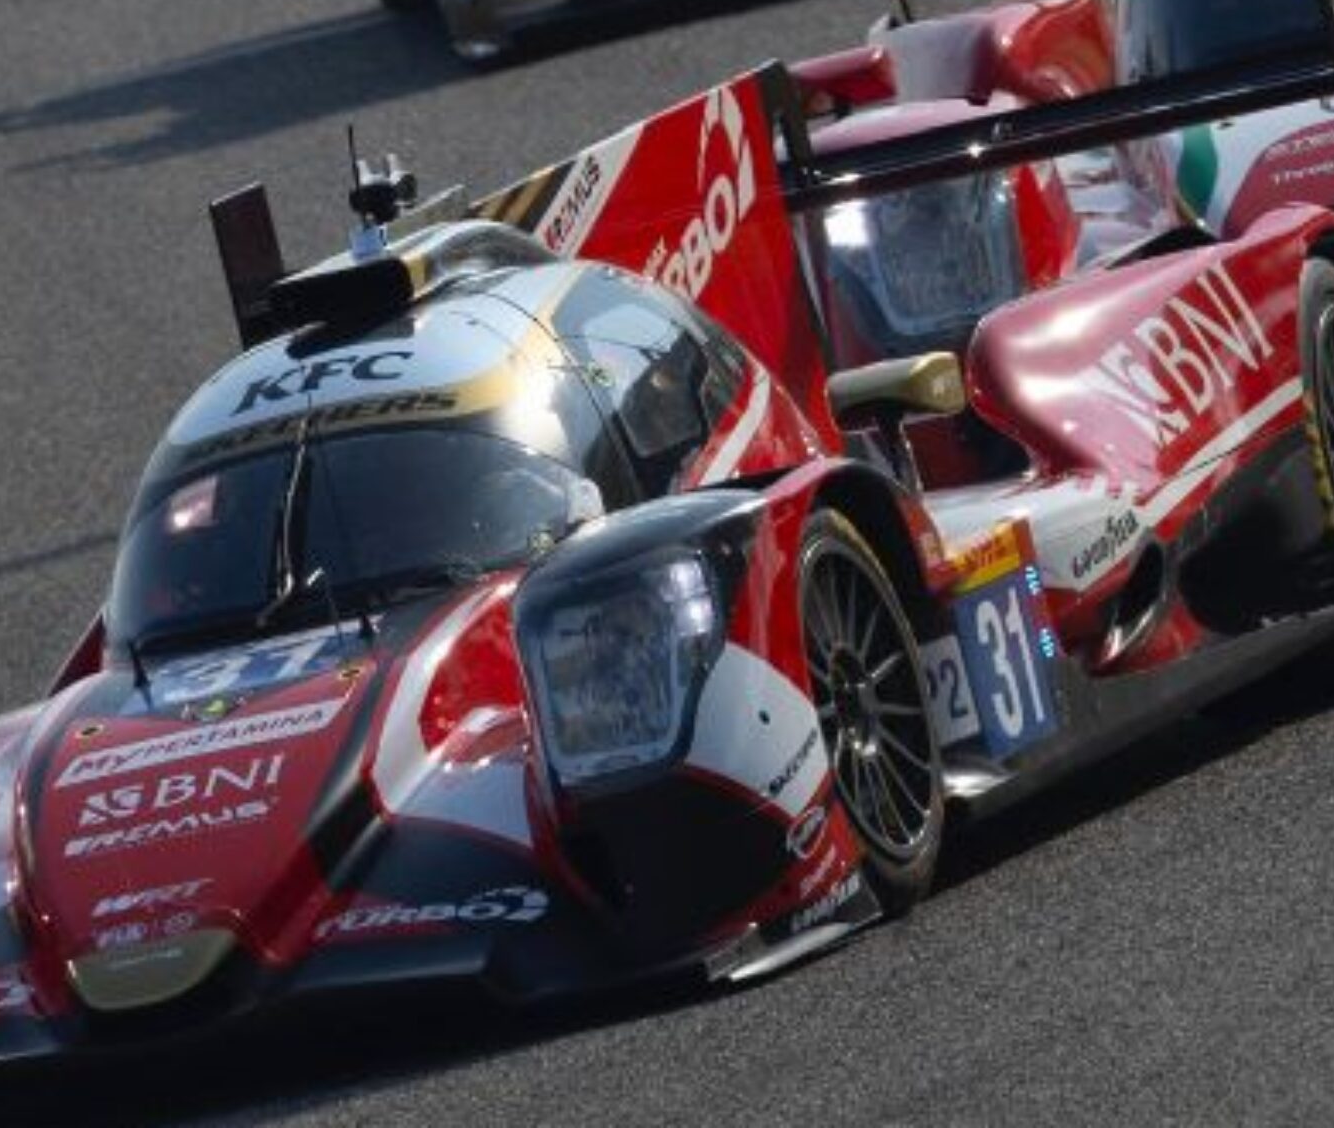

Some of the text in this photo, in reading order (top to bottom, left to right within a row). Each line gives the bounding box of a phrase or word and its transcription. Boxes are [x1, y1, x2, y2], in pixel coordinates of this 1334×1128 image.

[229, 350, 415, 416] KFC
[1134, 260, 1275, 416] BNI
[976, 586, 1045, 738] 31
[153, 752, 285, 810] BNI
